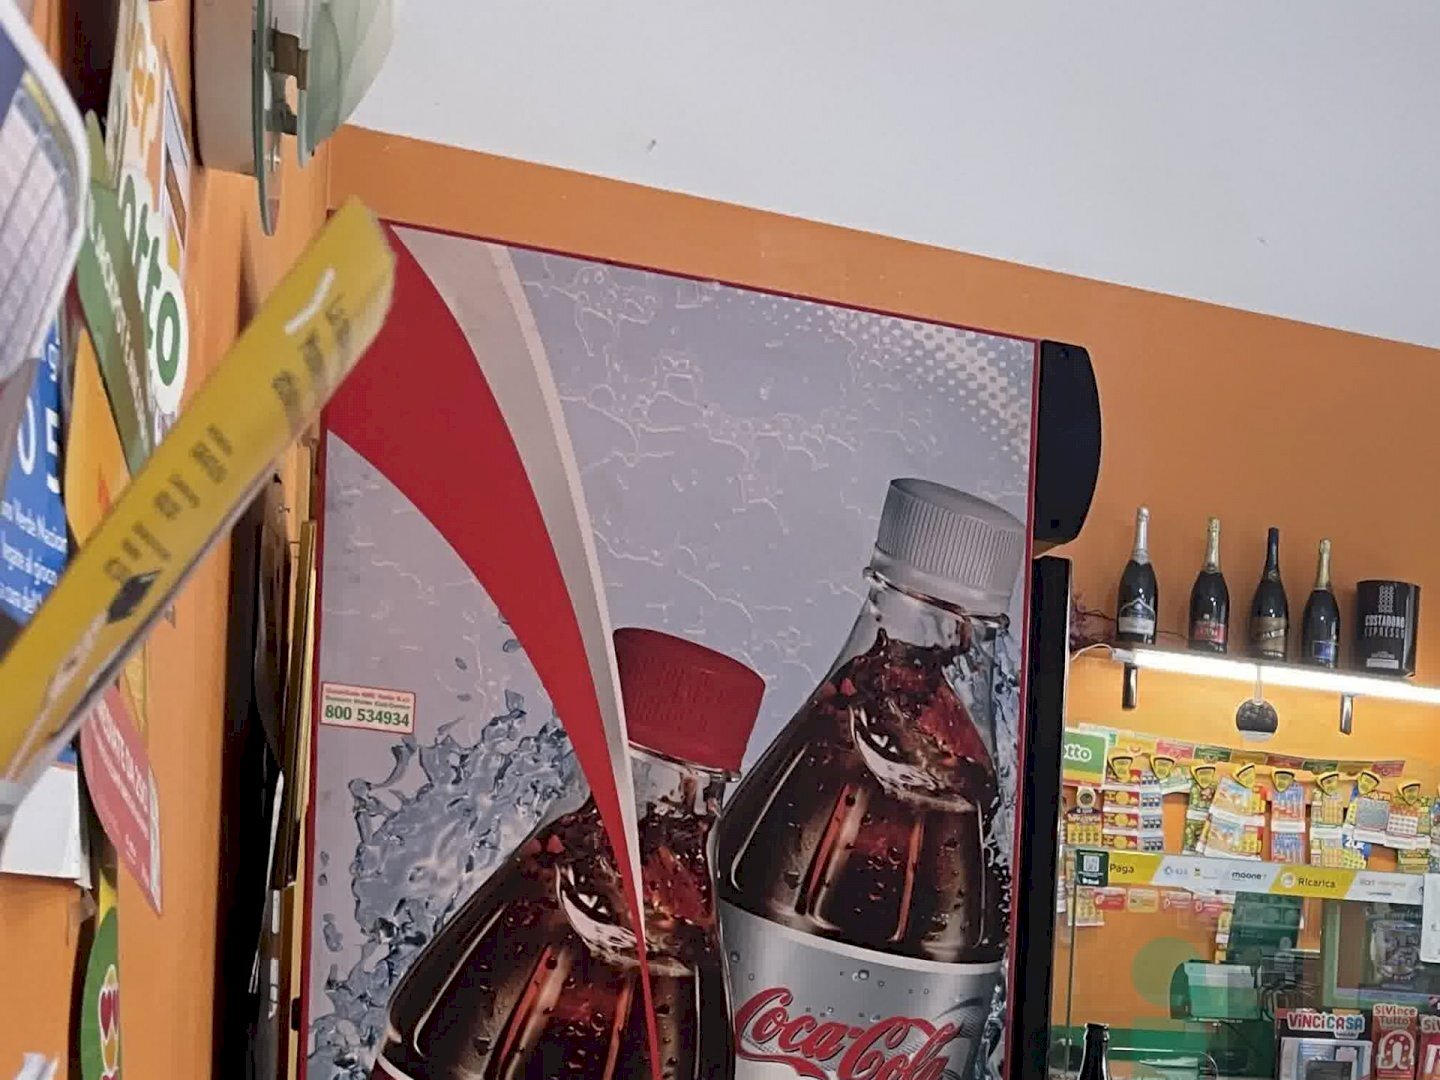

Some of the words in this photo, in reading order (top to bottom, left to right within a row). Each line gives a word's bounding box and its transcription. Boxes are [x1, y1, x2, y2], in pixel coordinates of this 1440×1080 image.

[325, 704, 352, 721] 800
[356, 708, 410, 727] 534934
[1109, 861, 1135, 876] Paga
[1298, 877, 1336, 889] Ricarica
